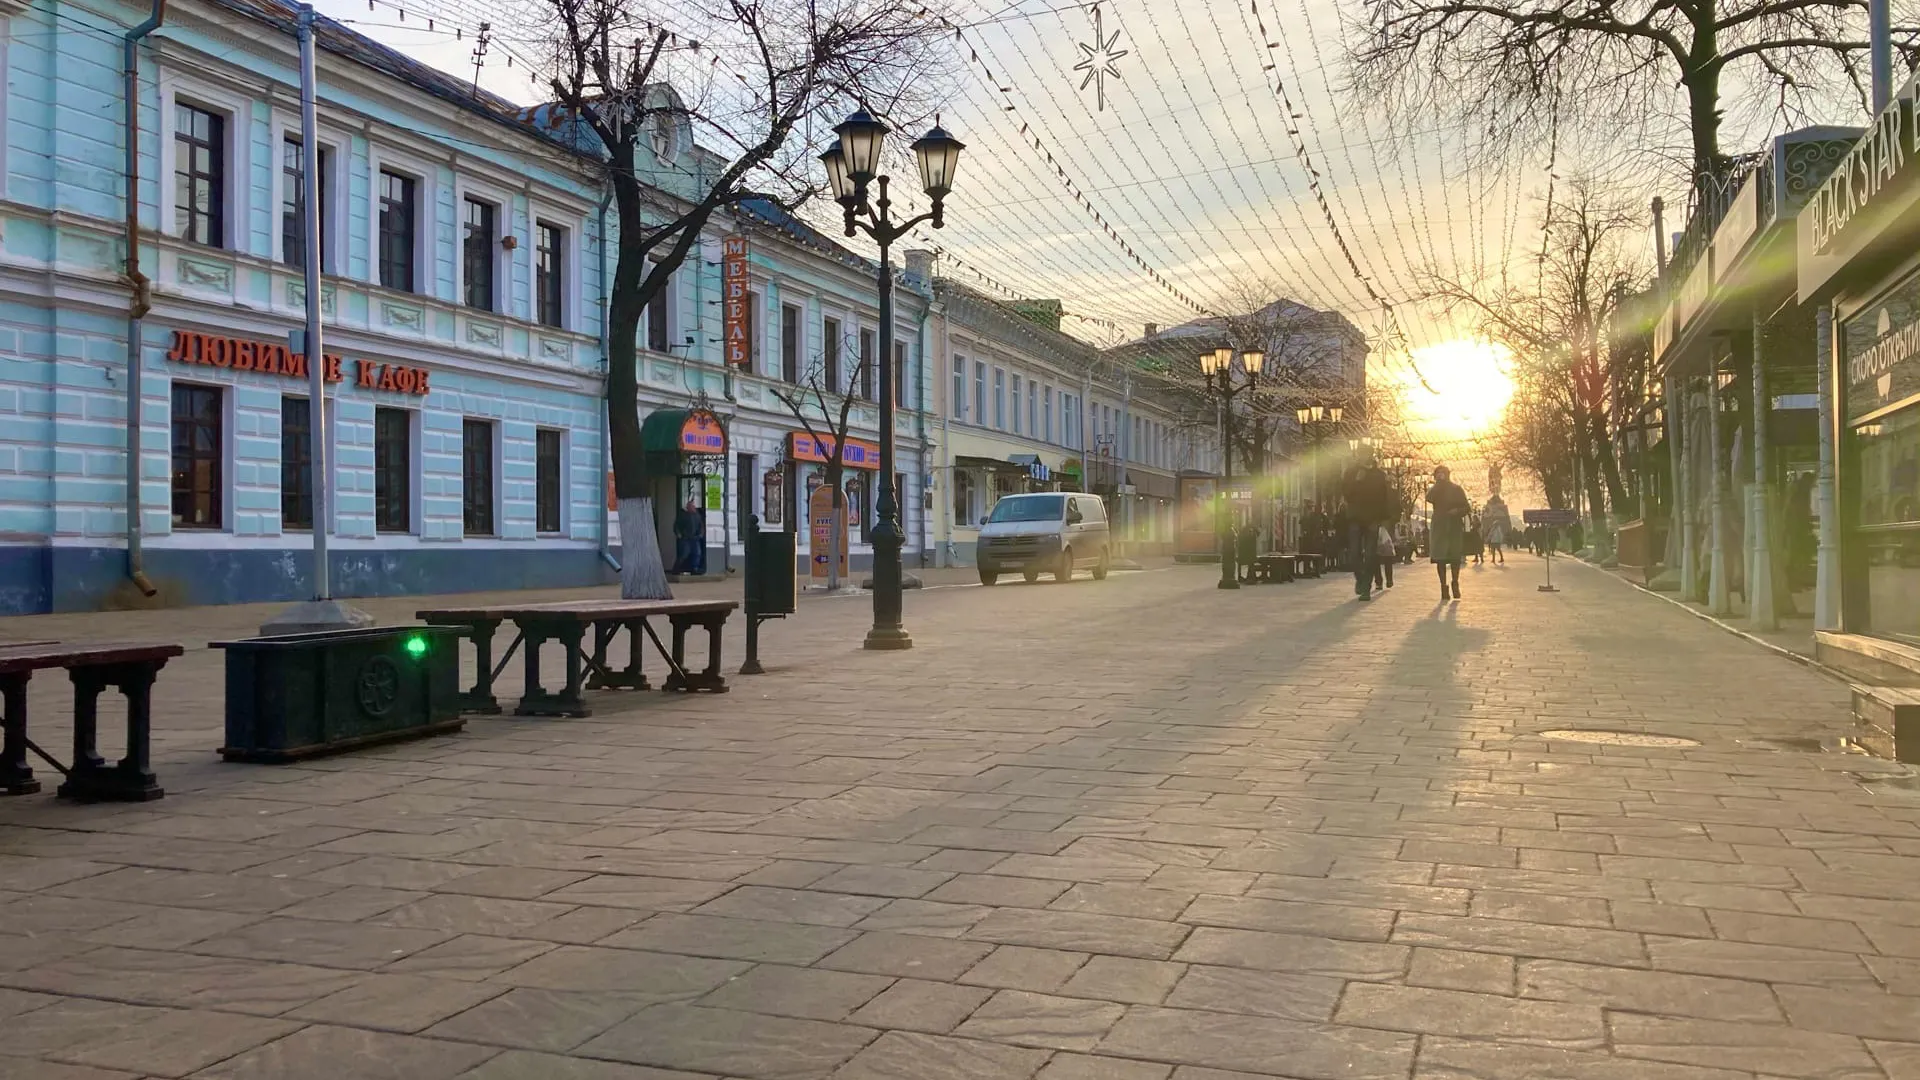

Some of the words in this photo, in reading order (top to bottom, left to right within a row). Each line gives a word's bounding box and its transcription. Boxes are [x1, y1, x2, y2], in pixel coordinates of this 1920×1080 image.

[1811, 148, 1857, 256] BLACK
[1859, 98, 1905, 207] STAR
[728, 240, 745, 361] МЕБЕЛЬ
[167, 330, 344, 383] ЛЮБИМЕ
[355, 359, 431, 396] КАФЕ
[1851, 345, 1878, 386] СКОРО
[1879, 319, 1920, 371] ОТКРЫТИ
